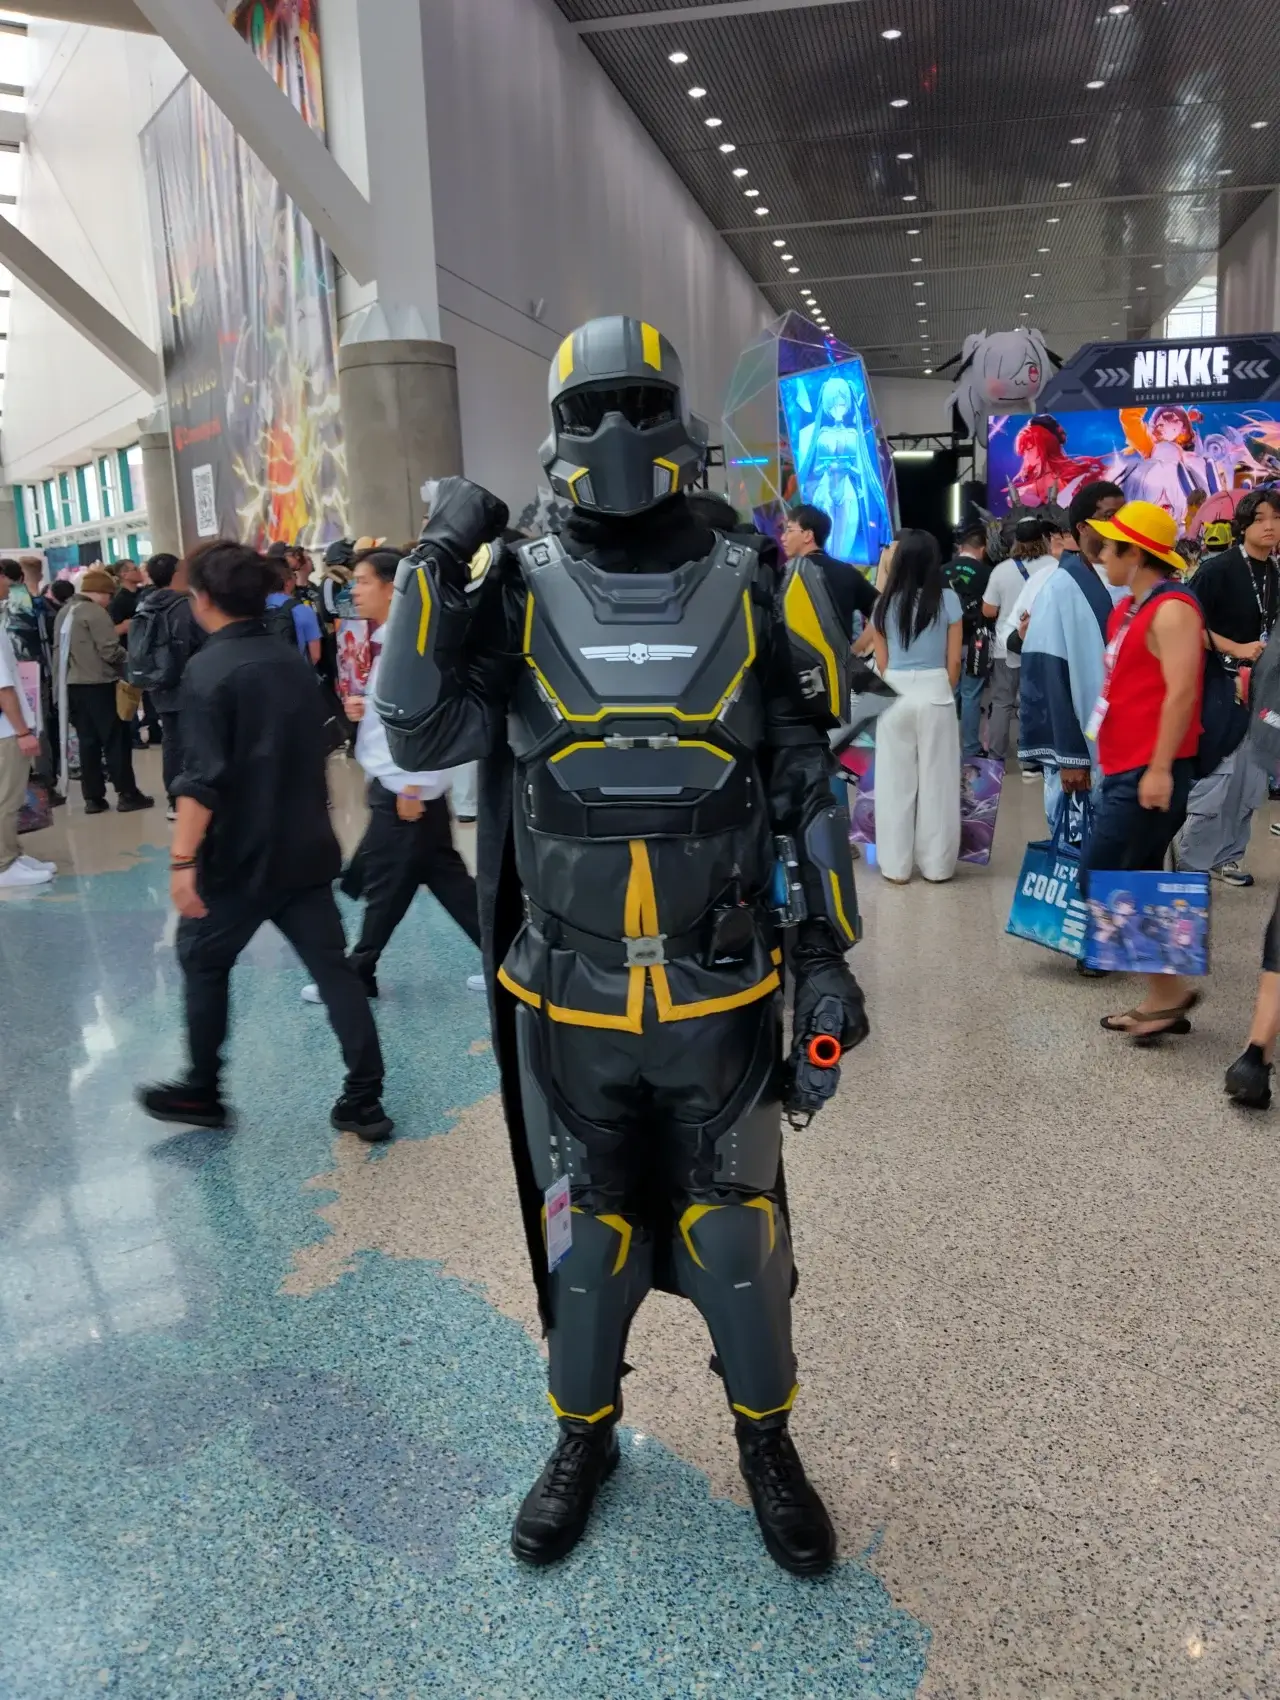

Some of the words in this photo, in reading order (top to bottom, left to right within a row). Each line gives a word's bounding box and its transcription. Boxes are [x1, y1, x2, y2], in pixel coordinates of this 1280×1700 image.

[1134, 346, 1230, 389] NIKKE
[1022, 871, 1068, 909] COOL
[1053, 862, 1079, 883] ICY
